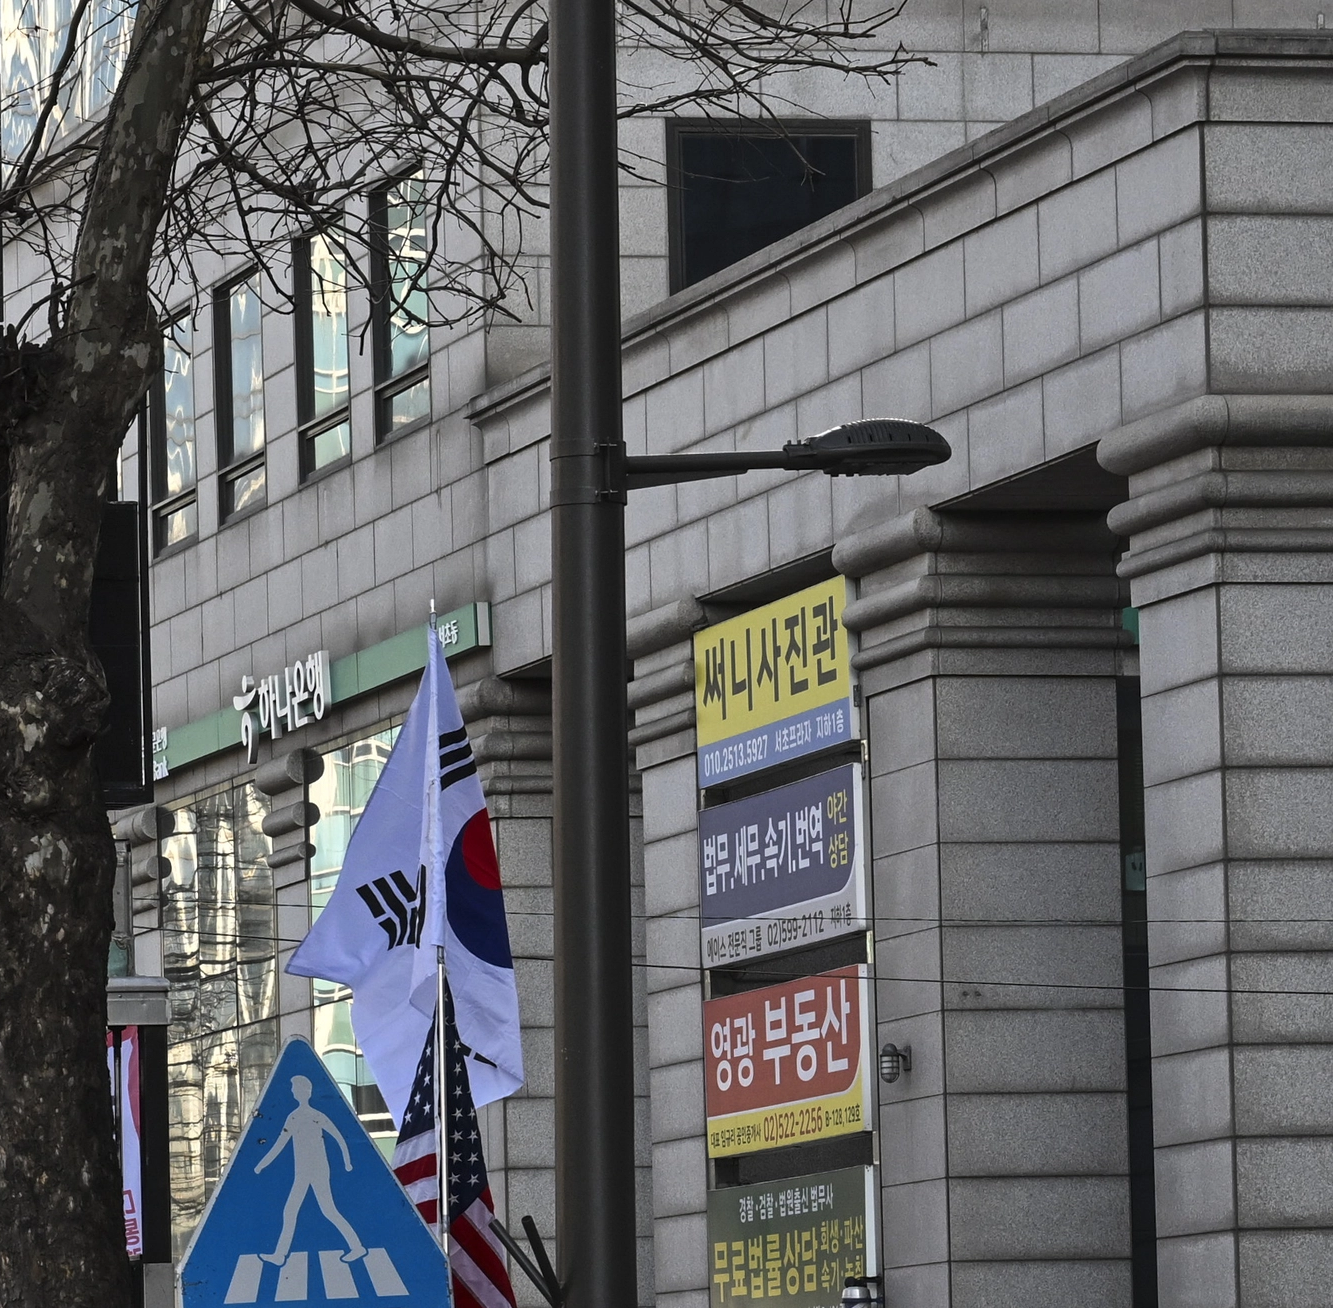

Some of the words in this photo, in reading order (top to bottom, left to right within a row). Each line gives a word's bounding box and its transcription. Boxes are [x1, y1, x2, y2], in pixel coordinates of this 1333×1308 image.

[702, 595, 838, 721] 써니사진관
[257, 650, 331, 740] 하나은행
[704, 735, 768, 777] 010.2513.5927
[774, 720, 813, 752] 서초프라자
[816, 708, 845, 740] 지하1층
[827, 788, 848, 825] 야간
[828, 830, 849, 869] 상담
[767, 910, 825, 948] 02)599-2112
[711, 1011, 757, 1092] 영광
[763, 978, 851, 1087] 부동산
[710, 1132, 721, 1149] 대표
[764, 1107, 824, 1146] 02)522-2256
[811, 1183, 834, 1212] 법무사
[714, 1227, 819, 1303] 무료법률상담
